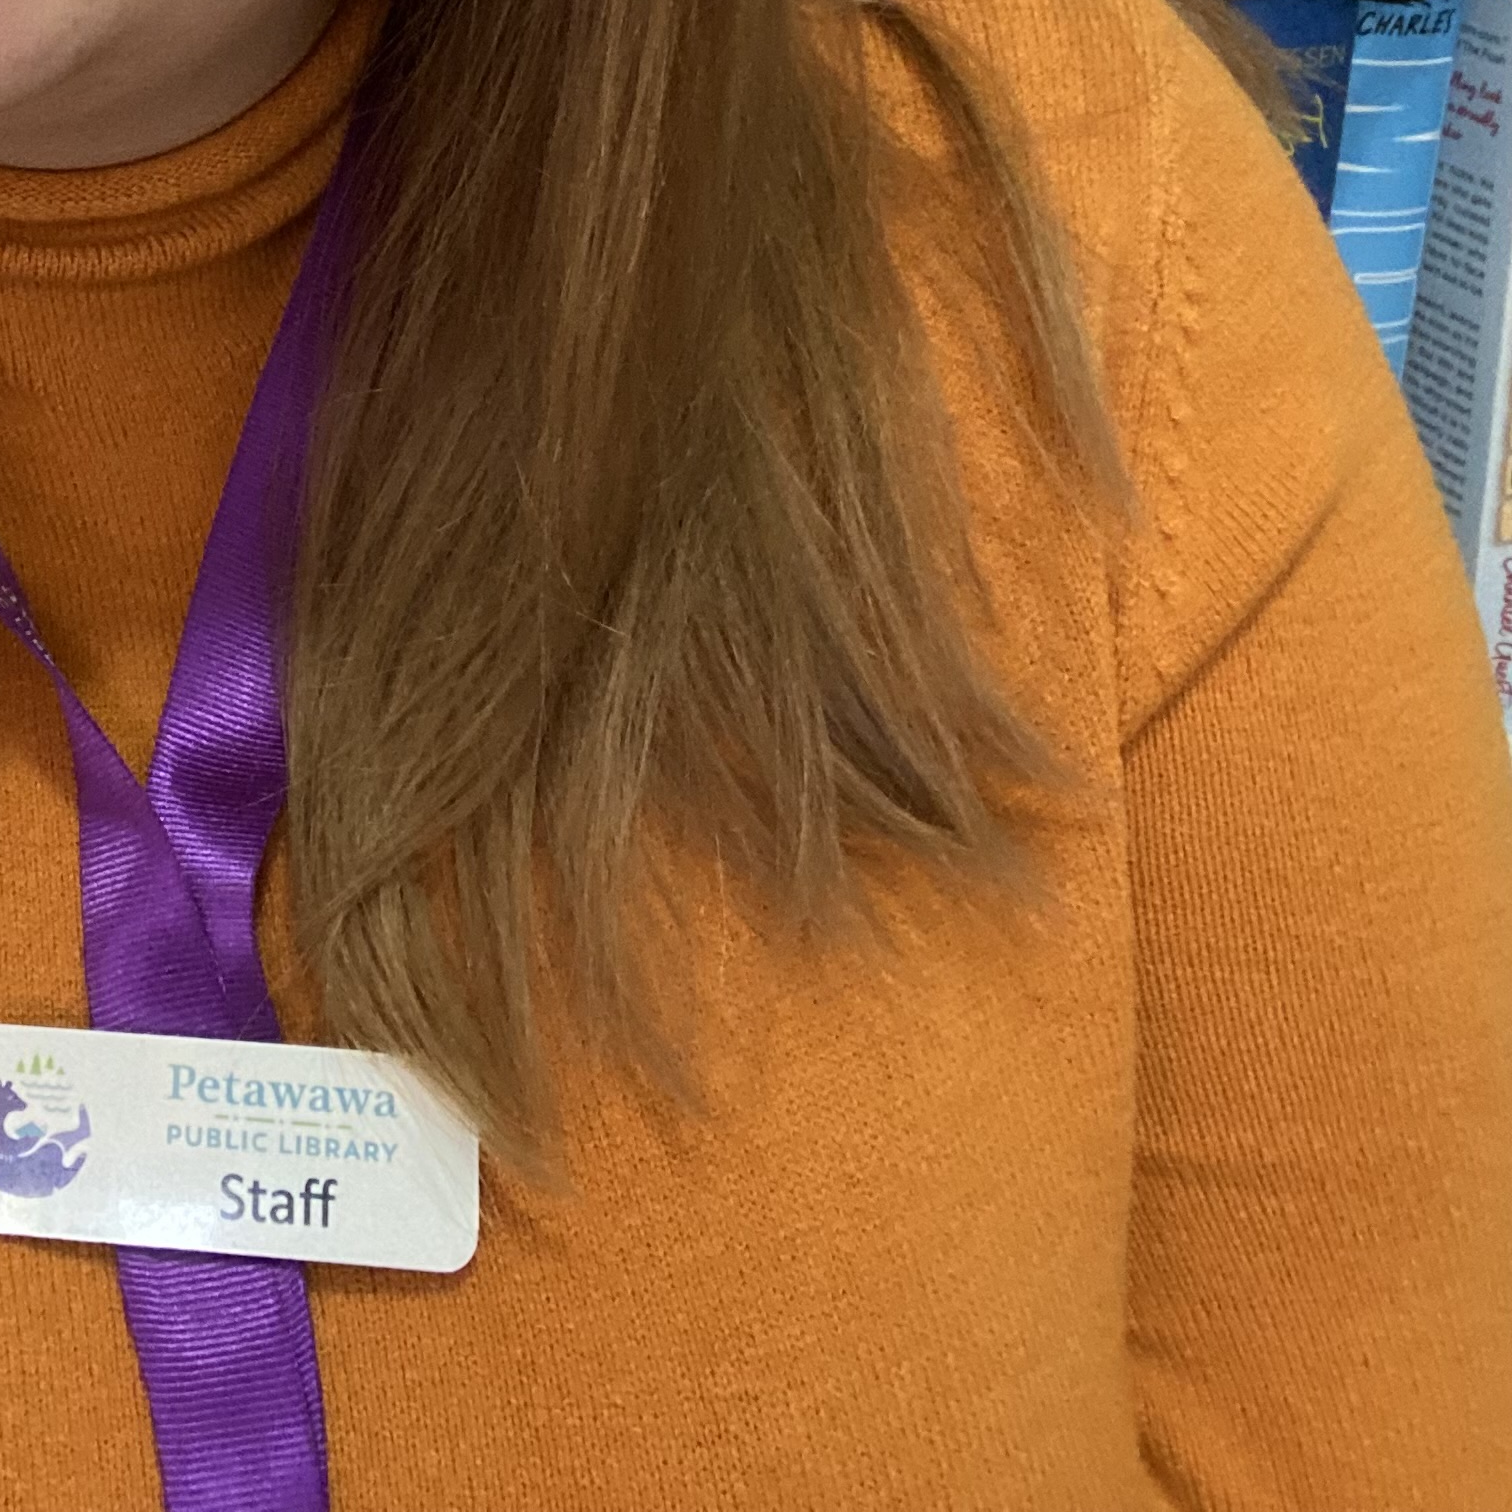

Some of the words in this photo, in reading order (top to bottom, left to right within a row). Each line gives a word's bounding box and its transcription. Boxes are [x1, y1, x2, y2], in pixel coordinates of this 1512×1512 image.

[1356, 7, 1457, 36] CHARLES
[165, 1063, 400, 1119] Petawawa
[166, 1124, 268, 1153] PUBLIC
[278, 1133, 399, 1164] LIBRARY
[219, 1172, 339, 1228] Staff
